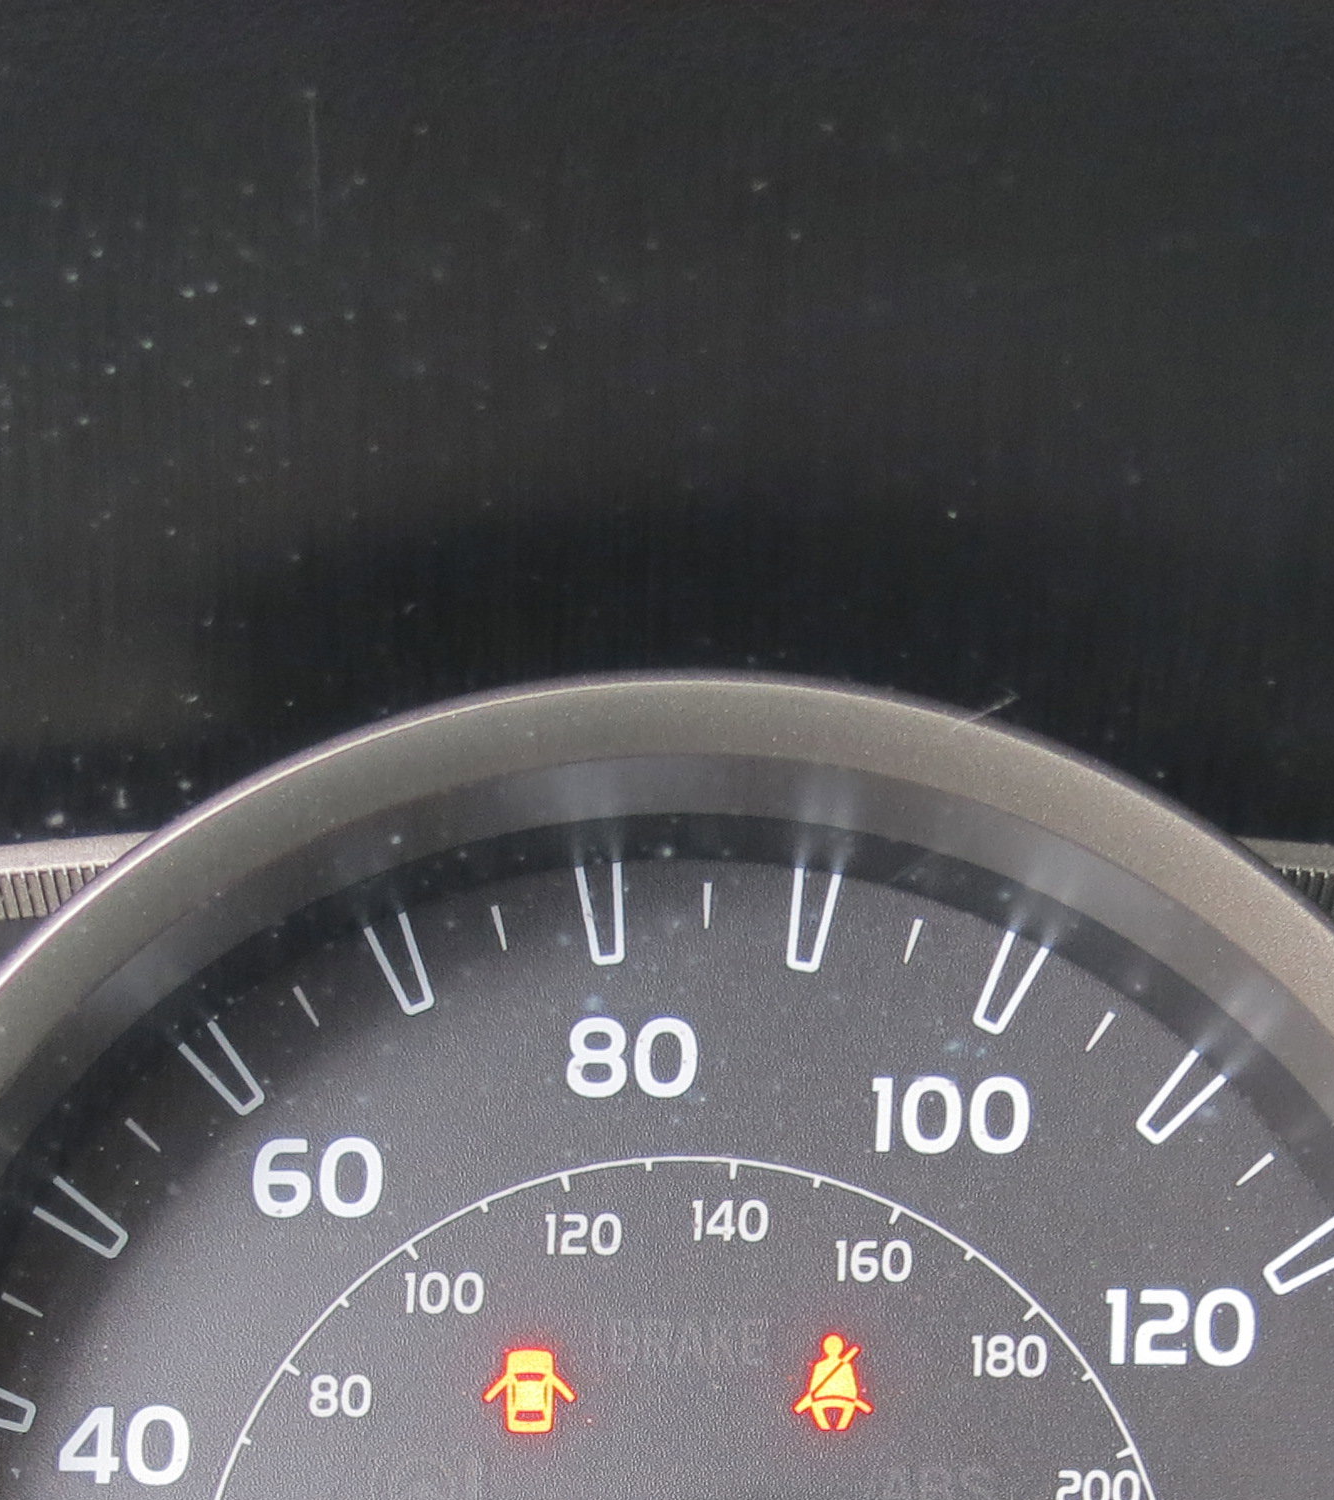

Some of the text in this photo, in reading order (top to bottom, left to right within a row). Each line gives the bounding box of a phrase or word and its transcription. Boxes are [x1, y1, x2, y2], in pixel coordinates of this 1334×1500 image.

[565, 1015, 699, 1099] 80
[871, 1074, 1031, 1156] 100
[251, 1135, 384, 1219] 60
[544, 1211, 623, 1257] 120
[691, 1198, 770, 1243] 140
[834, 1238, 914, 1284] 160
[403, 1270, 486, 1316] 100
[609, 1316, 772, 1368] BRAKE
[1104, 1286, 1257, 1368] 120
[970, 1333, 1049, 1379] 180
[307, 1373, 373, 1419] 80
[57, 1403, 192, 1487] 40
